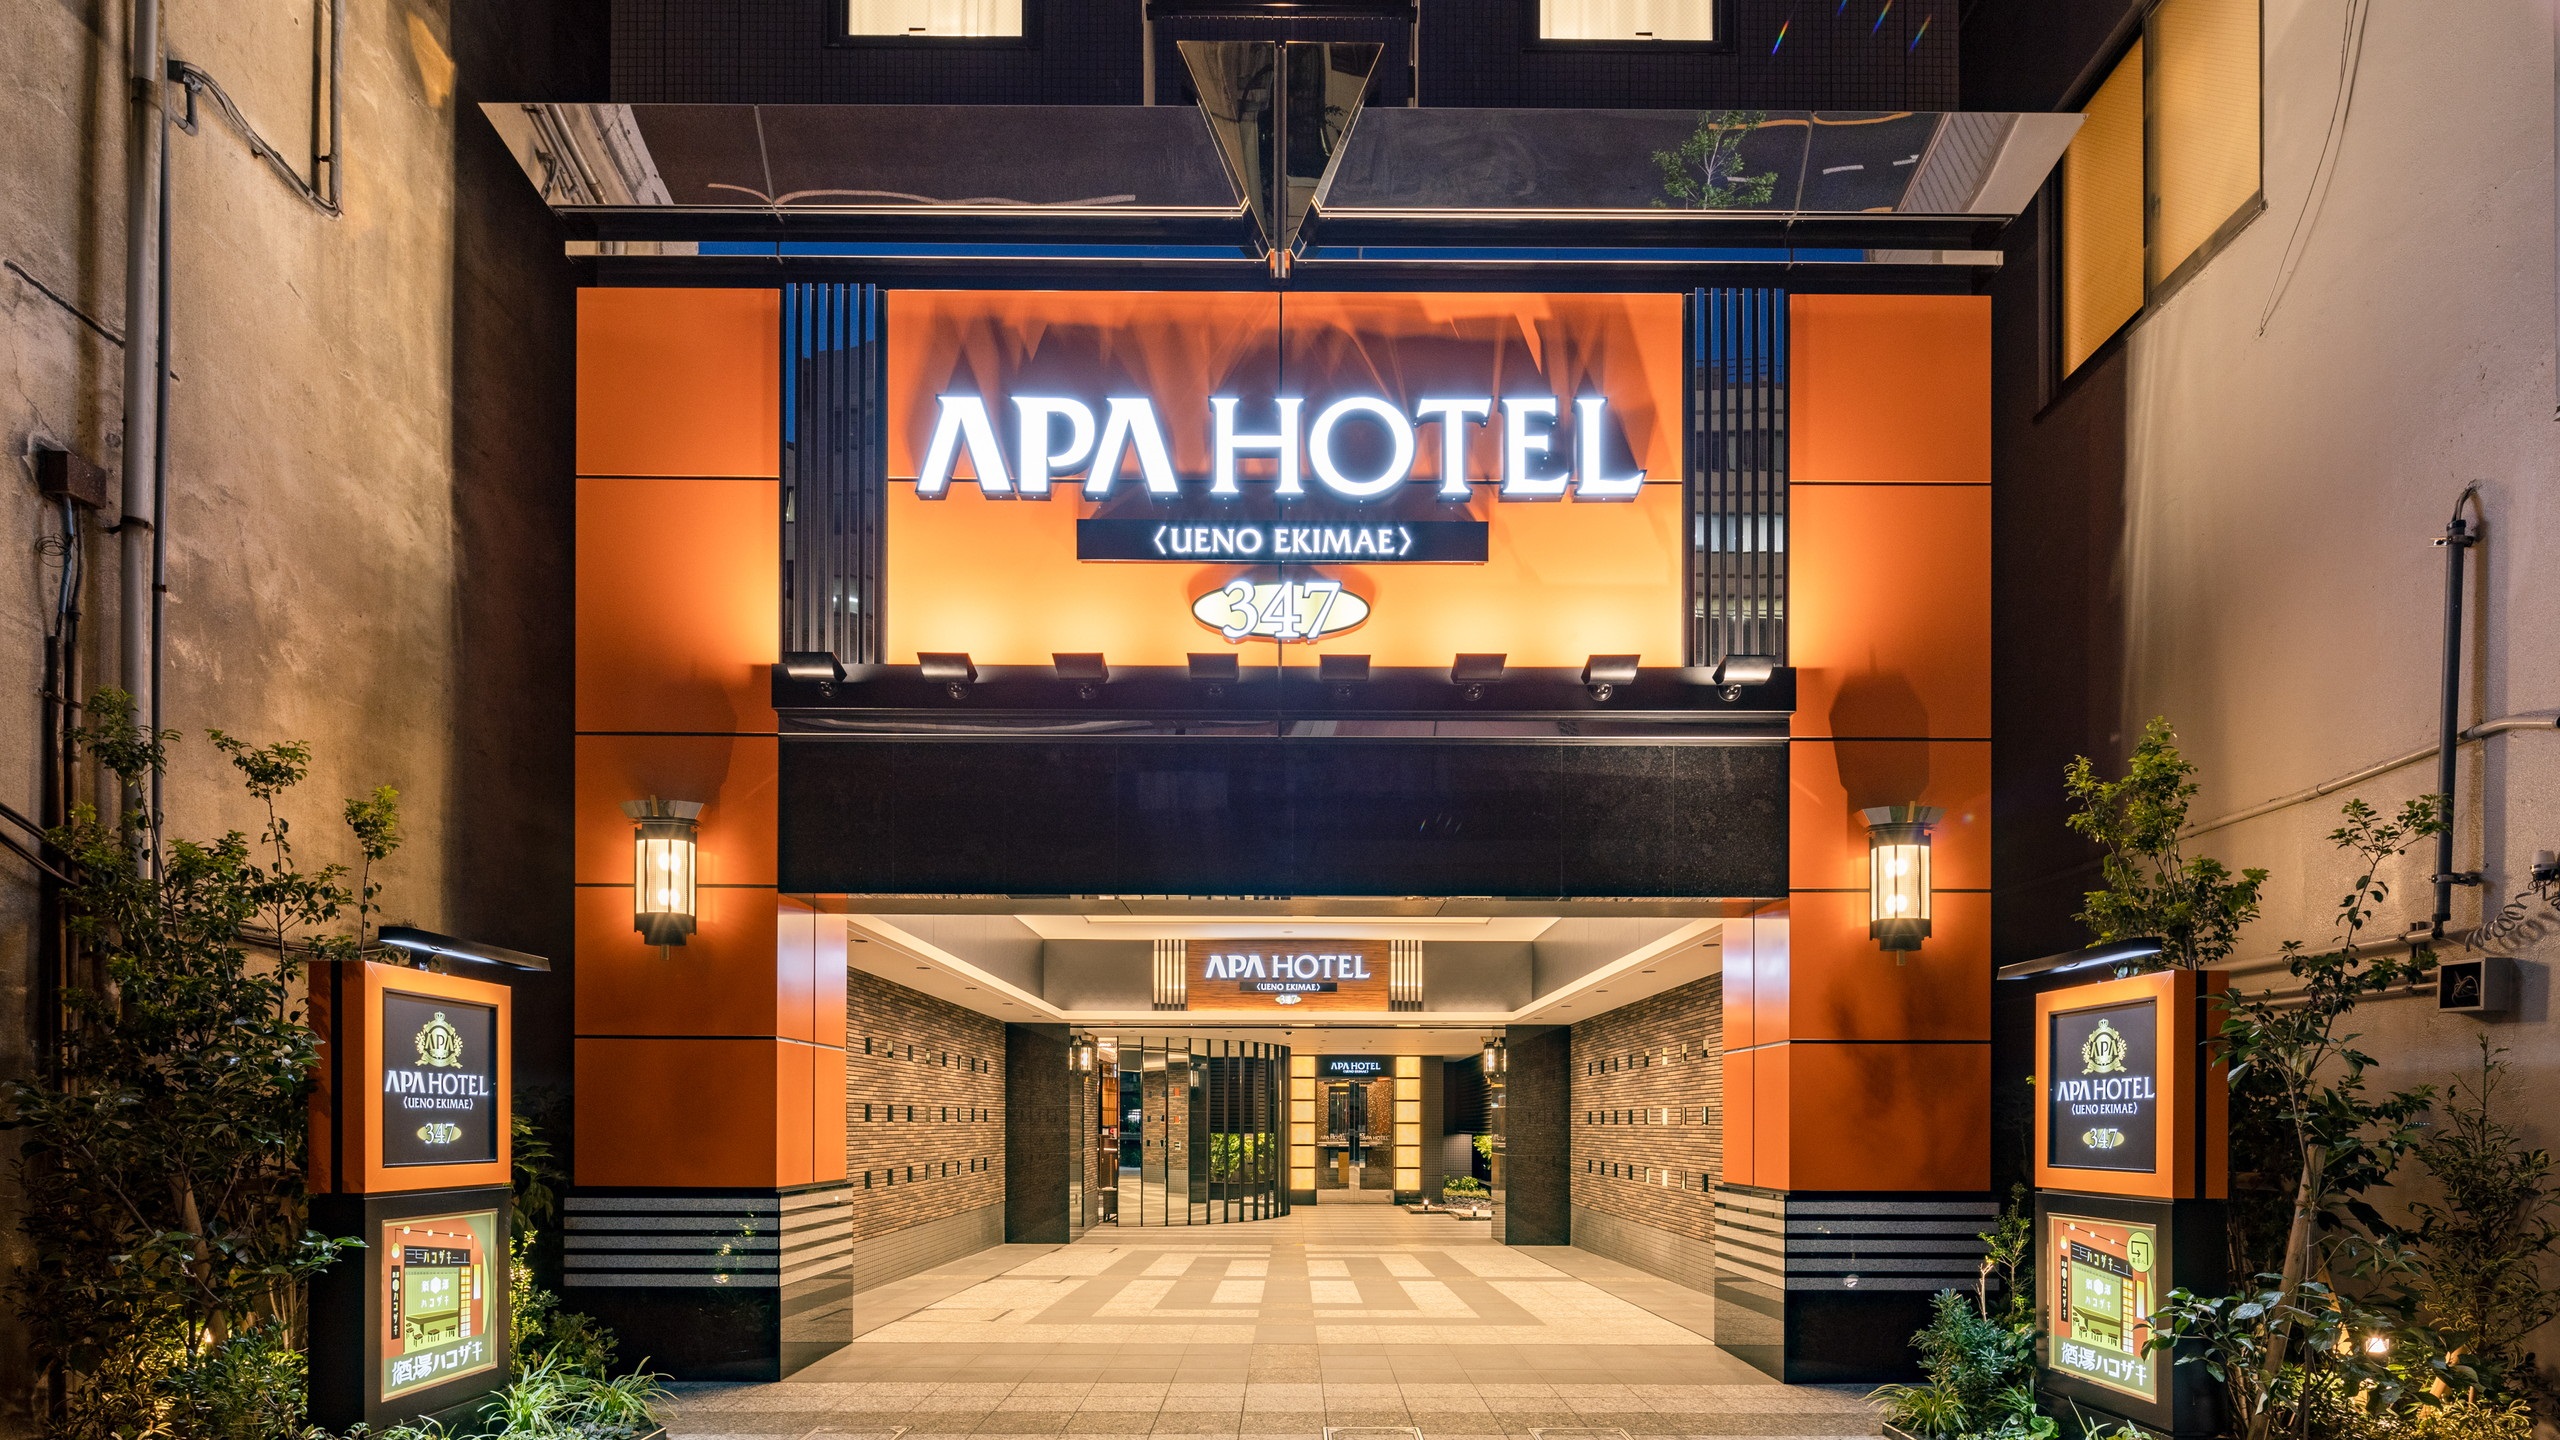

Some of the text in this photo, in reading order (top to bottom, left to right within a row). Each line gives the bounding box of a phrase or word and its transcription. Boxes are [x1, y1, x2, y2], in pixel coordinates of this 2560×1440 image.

[914, 395, 1646, 500] APA HOTEL
[1221, 580, 1342, 640] 347
[1205, 954, 1371, 980] APA HOTEL
[1331, 1062, 1381, 1070] APA HOTEL
[385, 1070, 489, 1096] APA HOTEL
[2057, 1076, 2155, 1102] APA HOTEL
[424, 1123, 455, 1144] 347
[2088, 1127, 2118, 1149] 347
[424, 1250, 452, 1264] ハコザキ
[2087, 1251, 2113, 1271] ハコザキ
[391, 1340, 483, 1387] 酒場ハコザキ
[2061, 1341, 2147, 1386] 酒場ハコザキ
